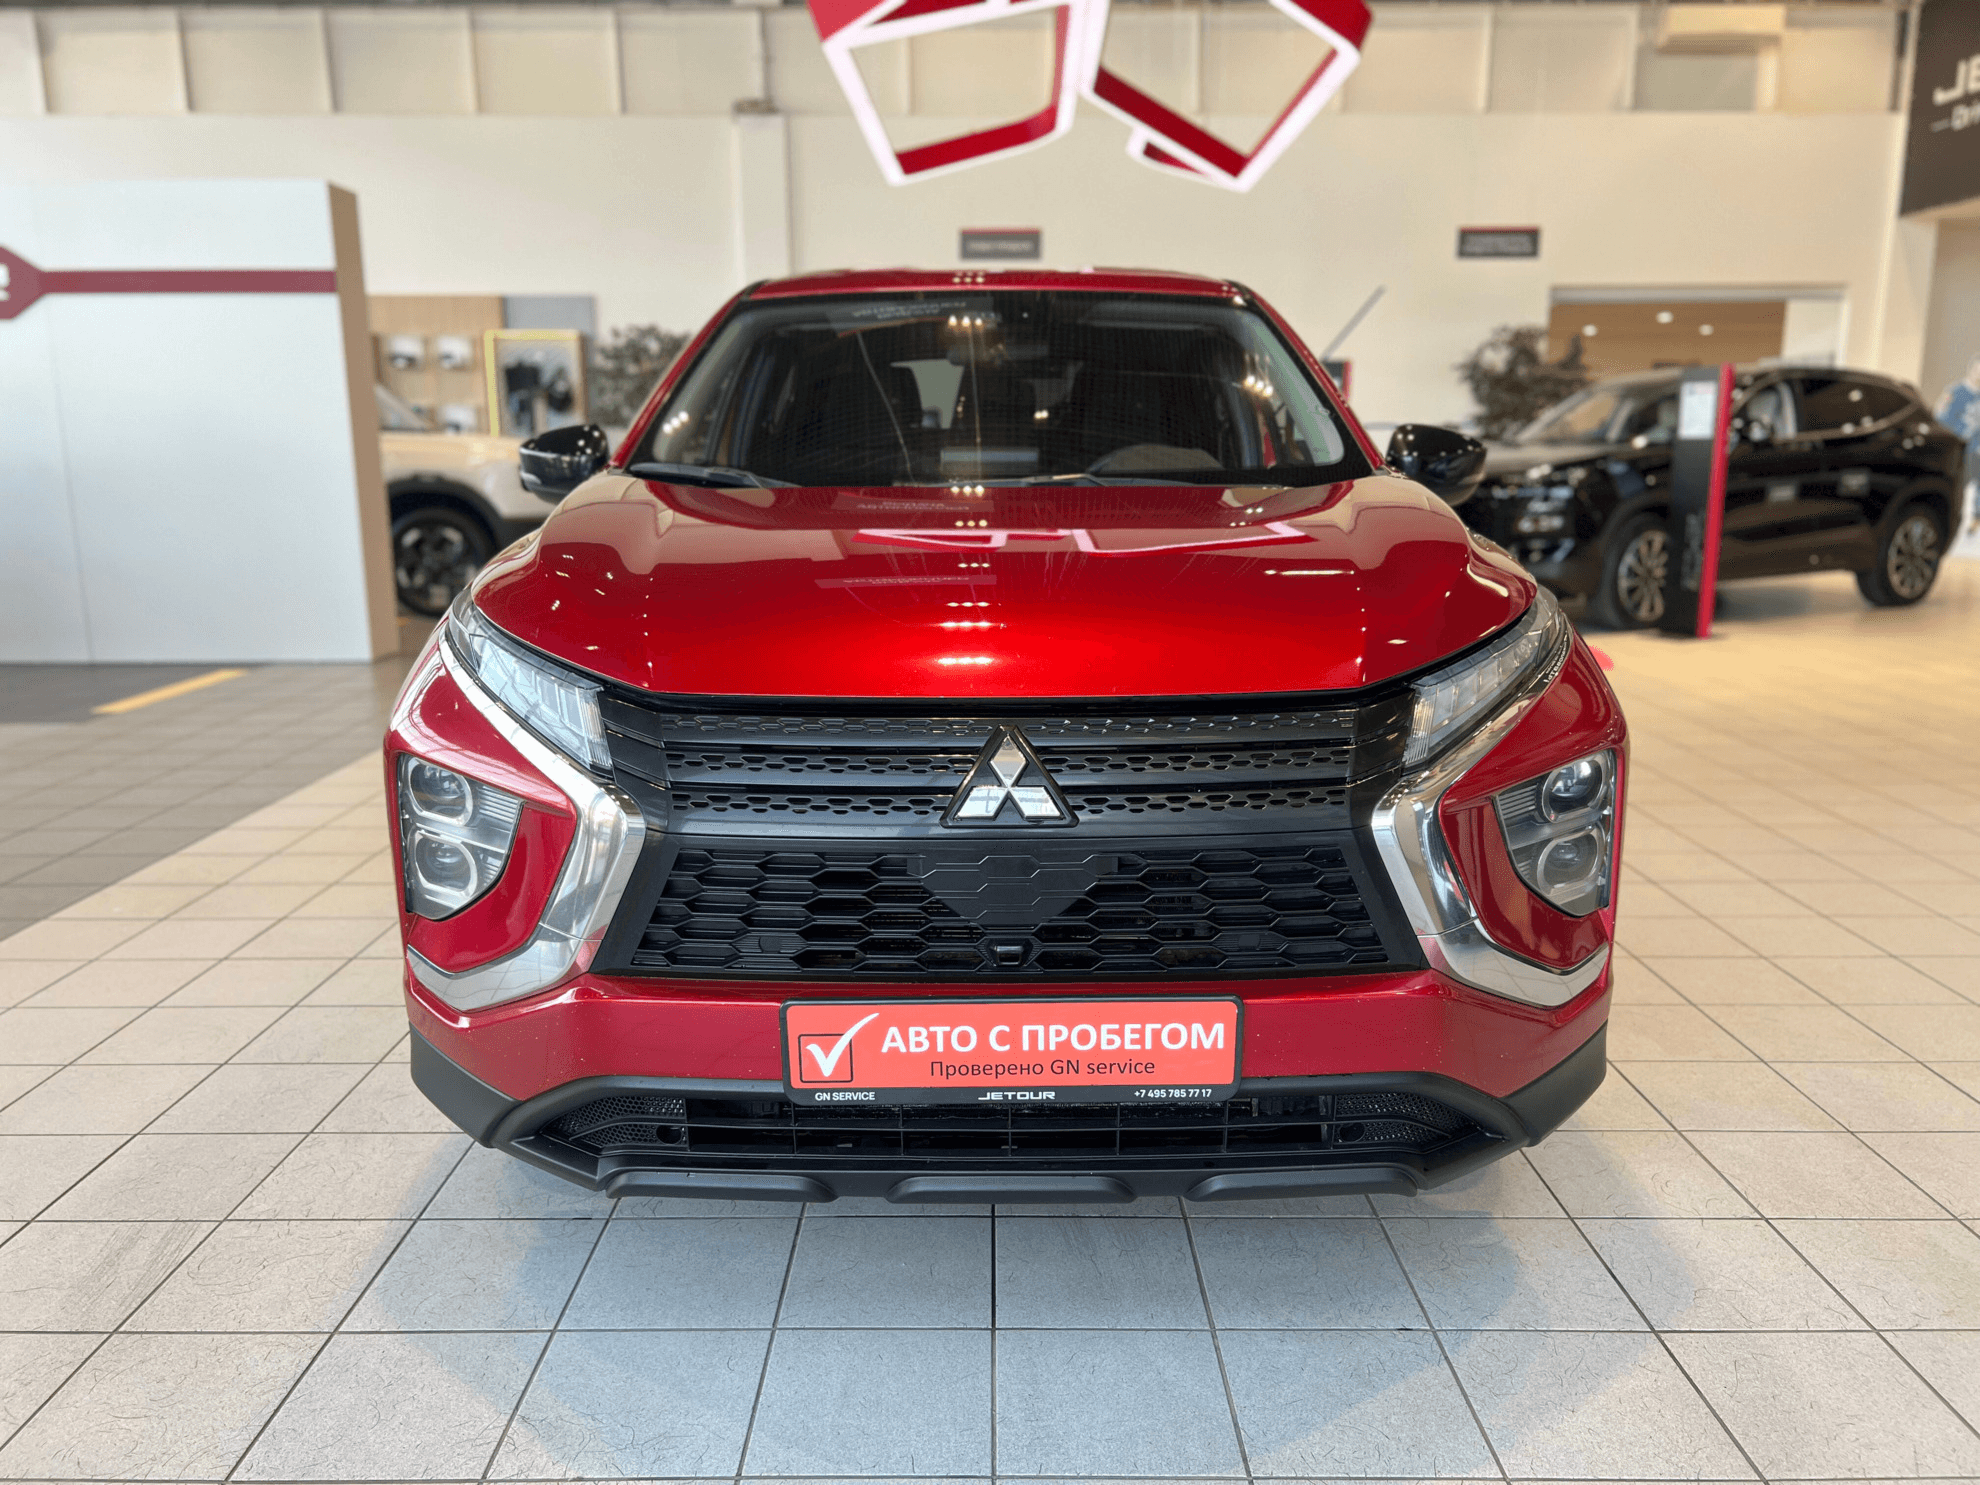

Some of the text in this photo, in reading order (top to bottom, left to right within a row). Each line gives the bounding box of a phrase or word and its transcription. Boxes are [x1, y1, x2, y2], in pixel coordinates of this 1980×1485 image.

[881, 1022, 1225, 1053] АВТО С ПРОБЕГОМ
[930, 1058, 1155, 1080] Проверено GN service
[815, 1091, 876, 1101] GN SERVICE
[977, 1091, 1056, 1101] JETOUR
[1134, 1088, 1212, 1098] +7 495 785 77 17
